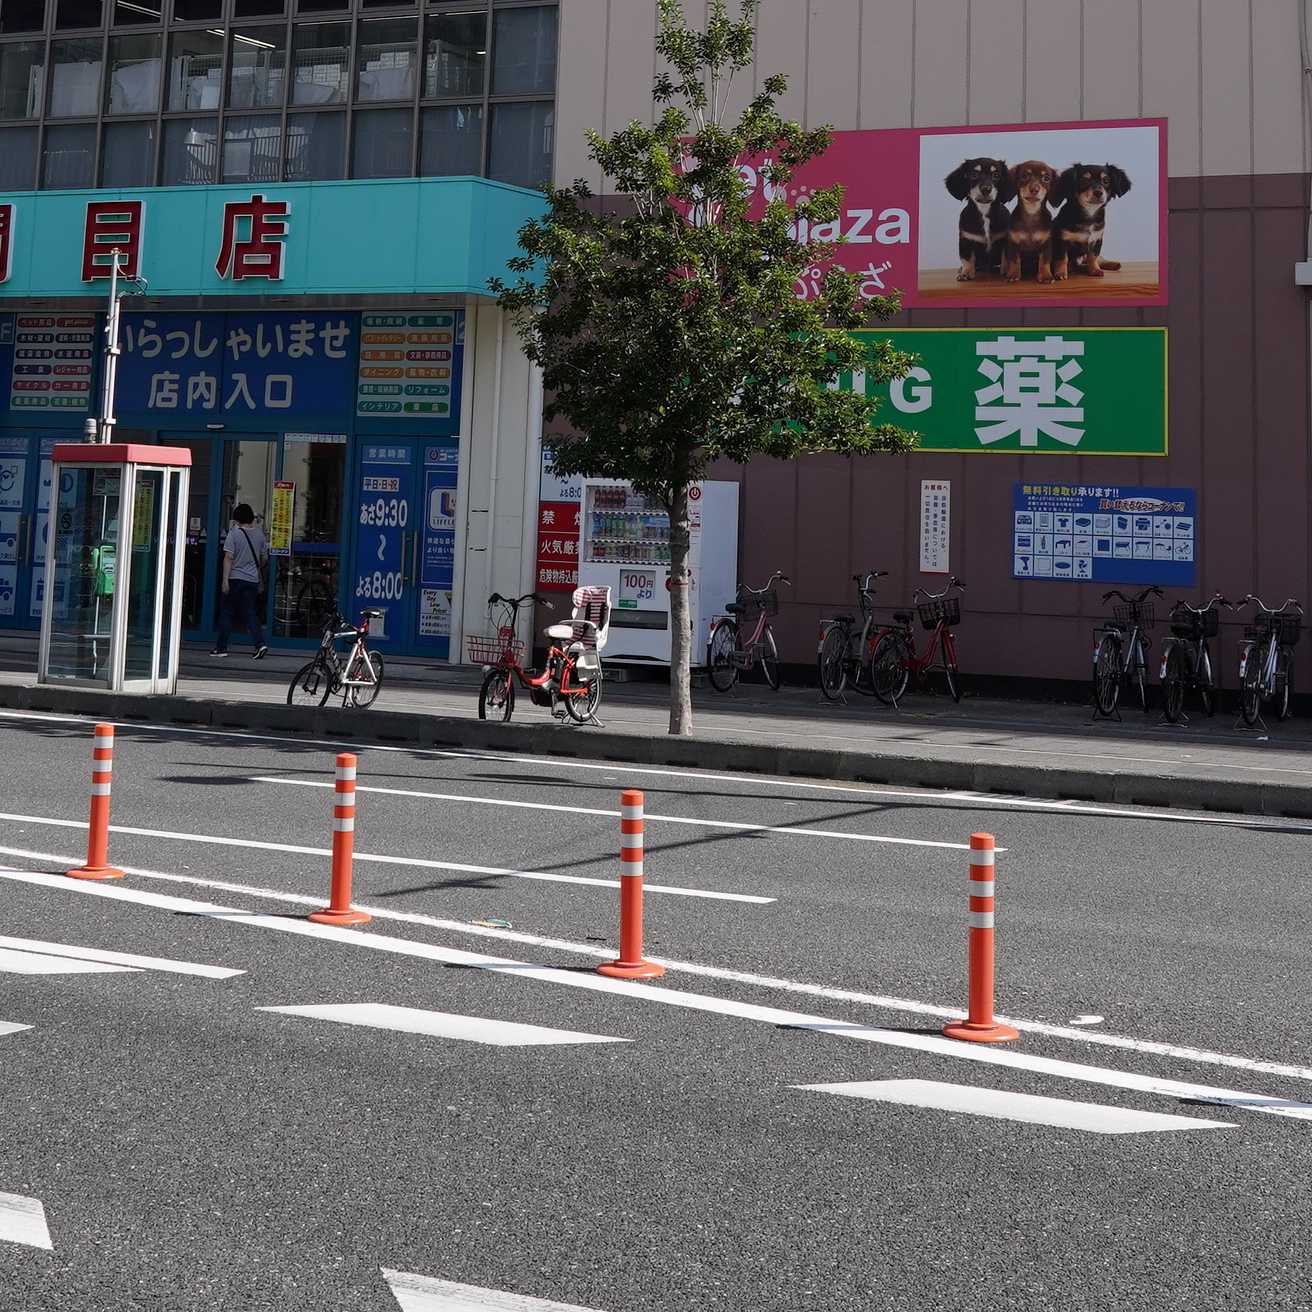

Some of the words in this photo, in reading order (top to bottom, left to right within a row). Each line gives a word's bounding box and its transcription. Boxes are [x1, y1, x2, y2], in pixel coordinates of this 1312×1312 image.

[118, 319, 350, 360] いらっしゃいませ
[147, 370, 293, 410] 店内入口
[974, 336, 1086, 446] 薬
[360, 498, 408, 527] あさ9:30
[356, 571, 404, 600] よる8:00
[624, 574, 653, 588] 100円
[637, 589, 652, 600] より
